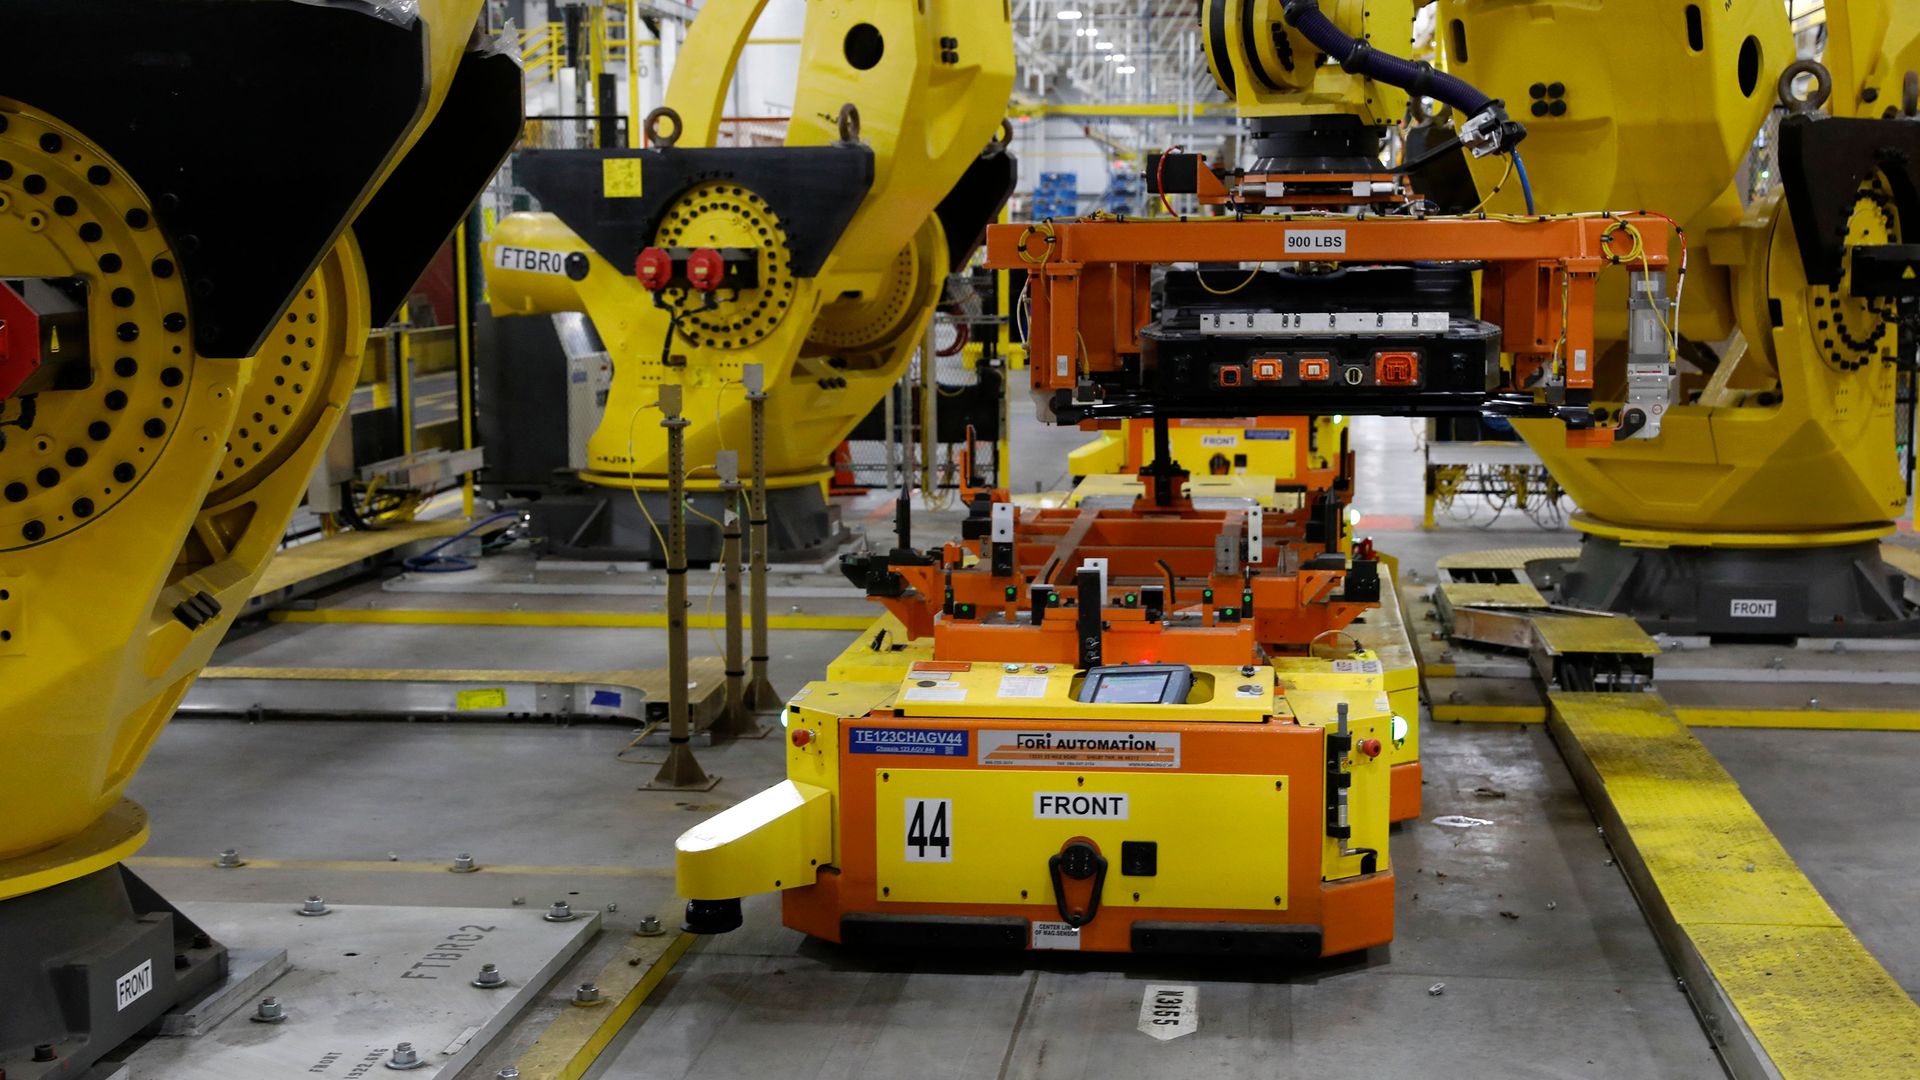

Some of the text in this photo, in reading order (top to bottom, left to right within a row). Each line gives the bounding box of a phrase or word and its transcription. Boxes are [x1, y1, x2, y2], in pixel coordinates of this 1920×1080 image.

[1288, 236, 1342, 248] 900 LBS
[1203, 437, 1235, 445] FRONT
[1733, 602, 1774, 615] FRONT
[855, 730, 962, 744] TE123CHAGV44
[1040, 796, 1123, 815] FRONT
[907, 801, 950, 858] 44
[119, 965, 150, 1006] FRONT
[308, 1051, 343, 1073] FRONT
